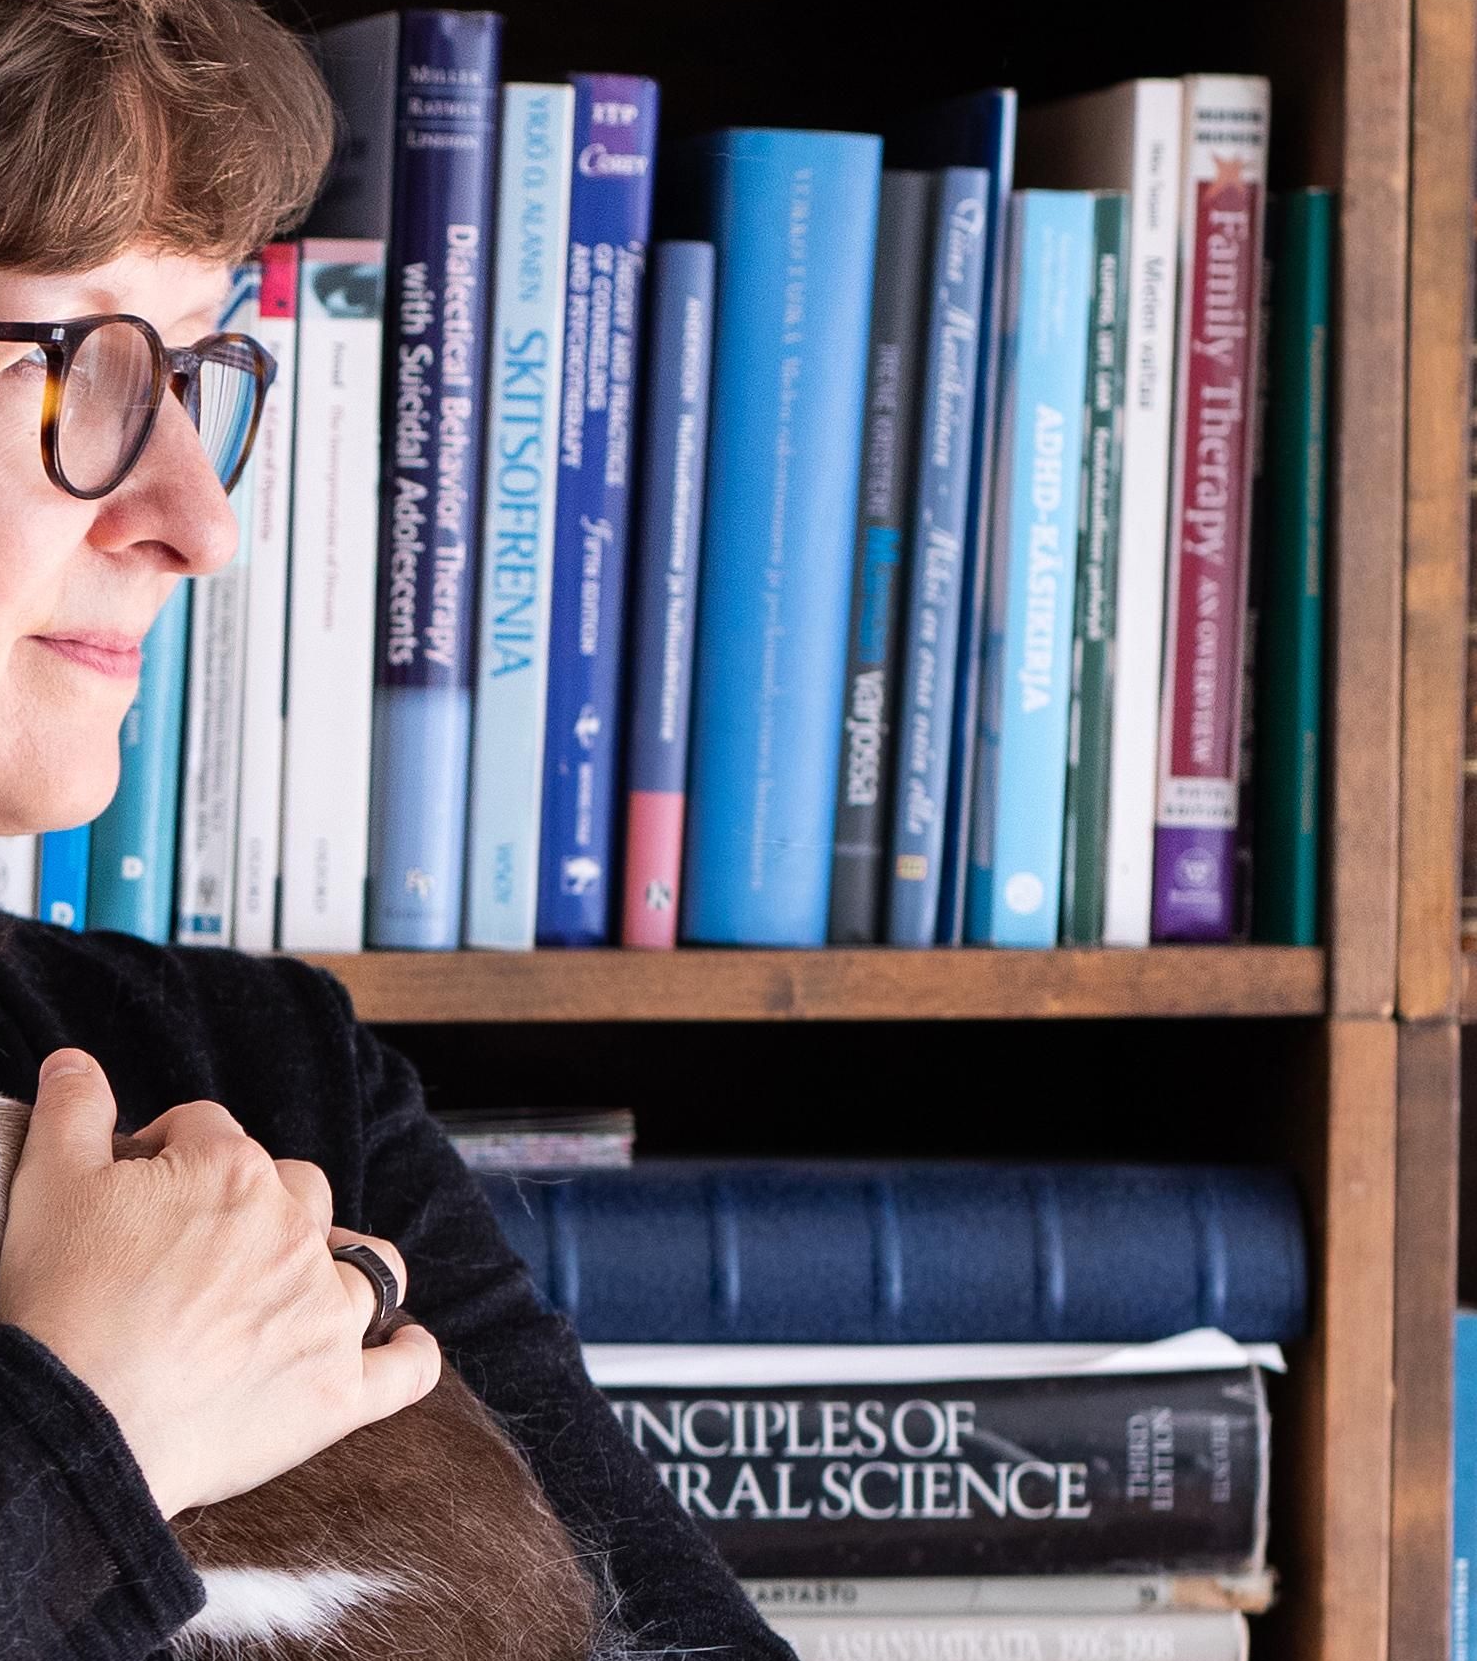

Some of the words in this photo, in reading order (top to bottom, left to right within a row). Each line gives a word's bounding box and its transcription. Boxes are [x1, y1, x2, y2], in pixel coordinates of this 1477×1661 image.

[402, 261, 434, 336] with
[444, 223, 480, 388] Dialectical
[1202, 206, 1250, 365] Family
[394, 343, 434, 468] Suicidal
[433, 395, 473, 535] Behavior
[1183, 378, 1244, 568] Therapy
[386, 477, 428, 666] Adolescents
[489, 329, 547, 680] SKITSOFRENIA
[1017, 404, 1067, 713] ADHD-KÄSIKIRJA
[422, 545, 467, 665] Therapy
[849, 670, 885, 806] varjossa
[818, 1463, 1093, 1520] SCIENCE
[891, 1401, 976, 1455] OF
